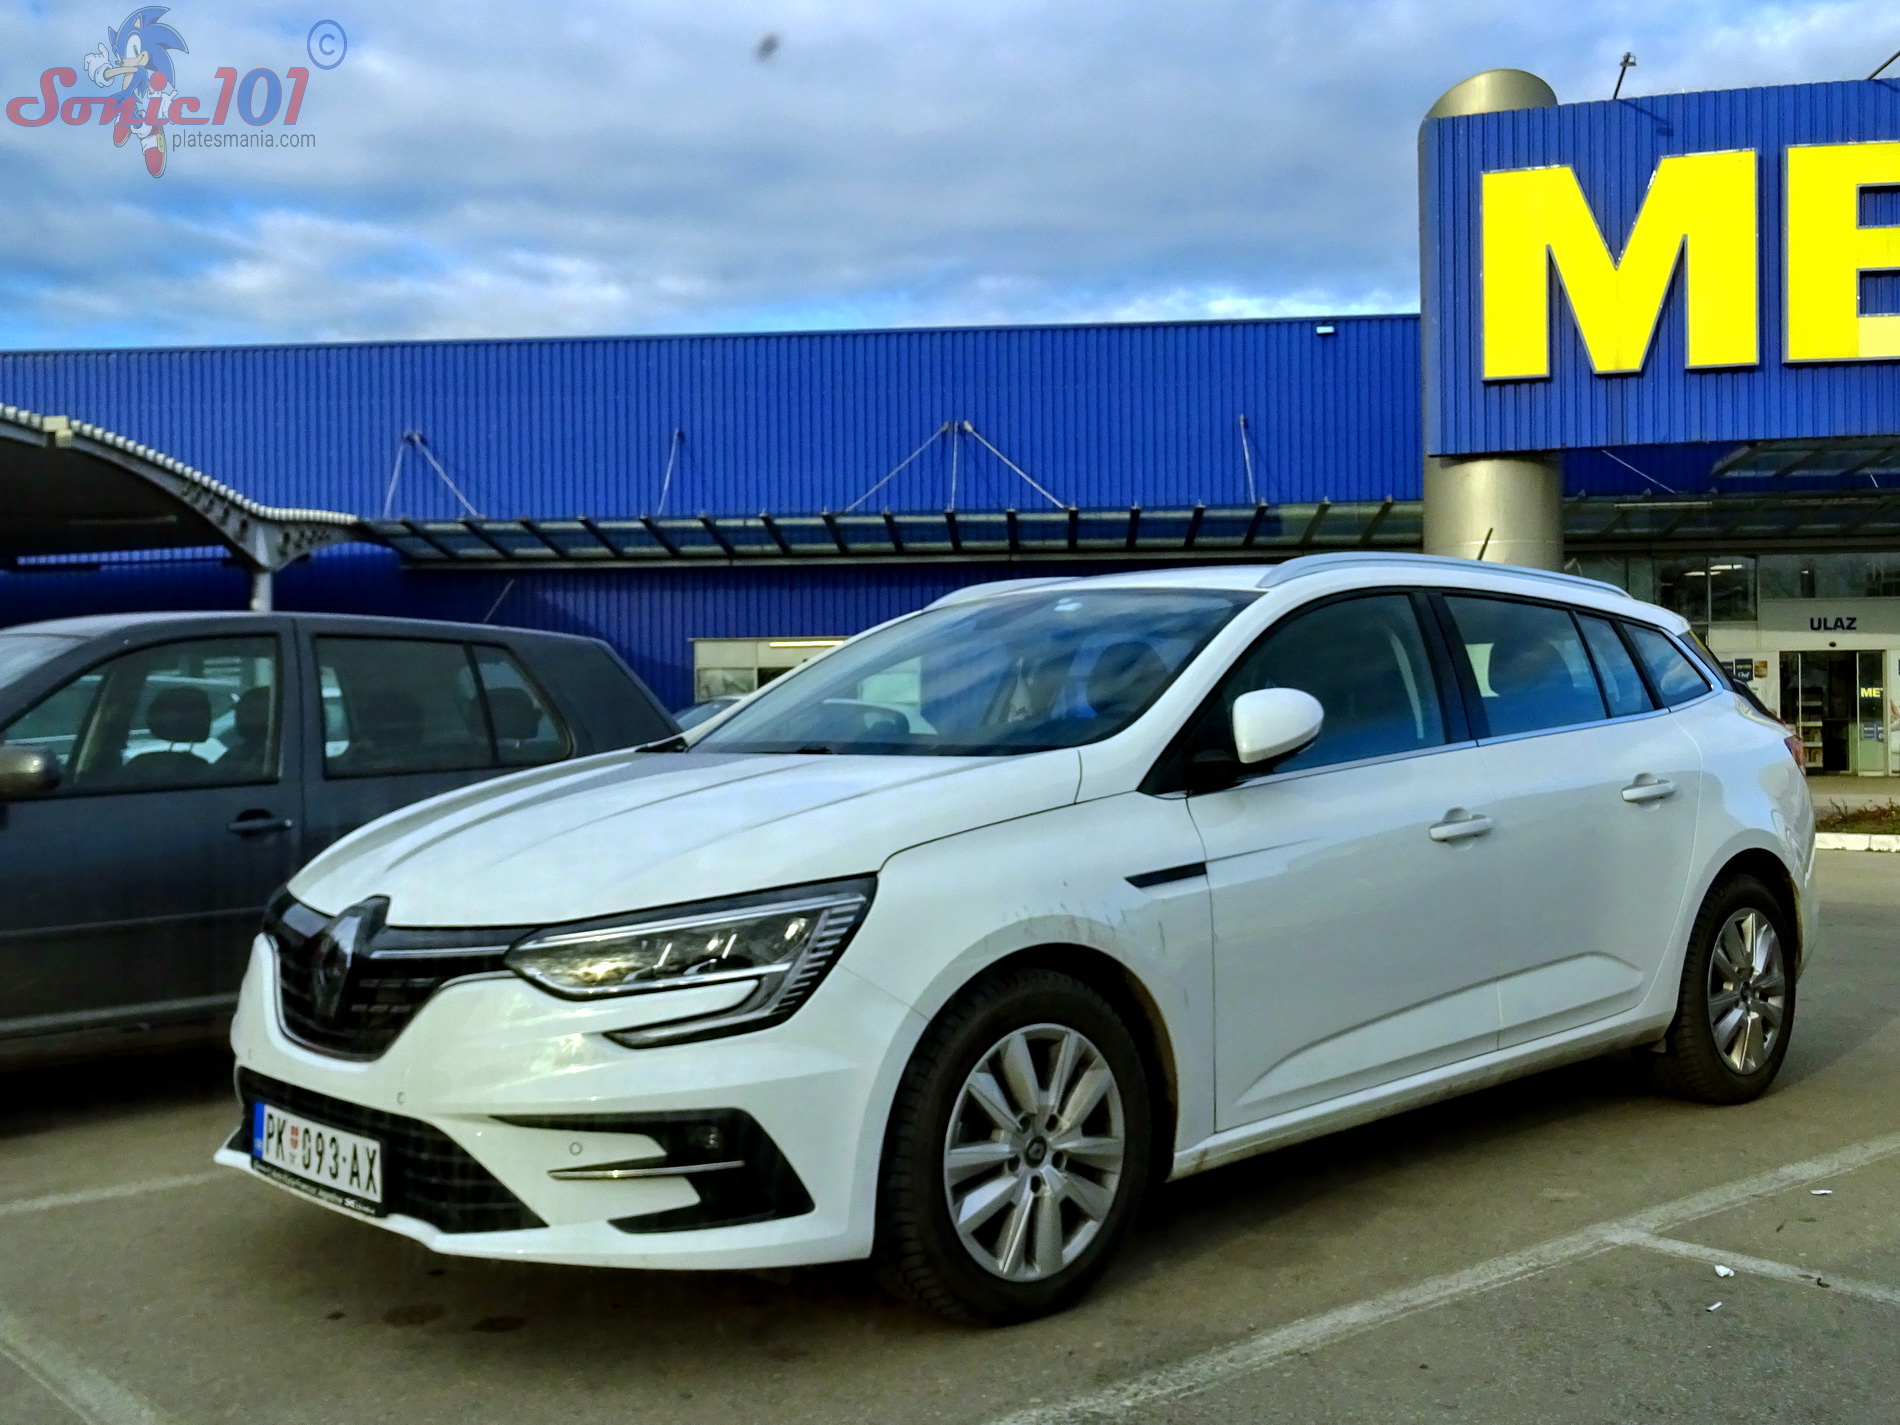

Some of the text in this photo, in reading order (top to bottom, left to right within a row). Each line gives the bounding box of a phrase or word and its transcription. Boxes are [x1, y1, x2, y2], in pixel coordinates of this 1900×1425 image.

[1481, 140, 1900, 382] ME
[1809, 617, 1857, 631] ULAZ
[266, 1113, 286, 1161] PK
